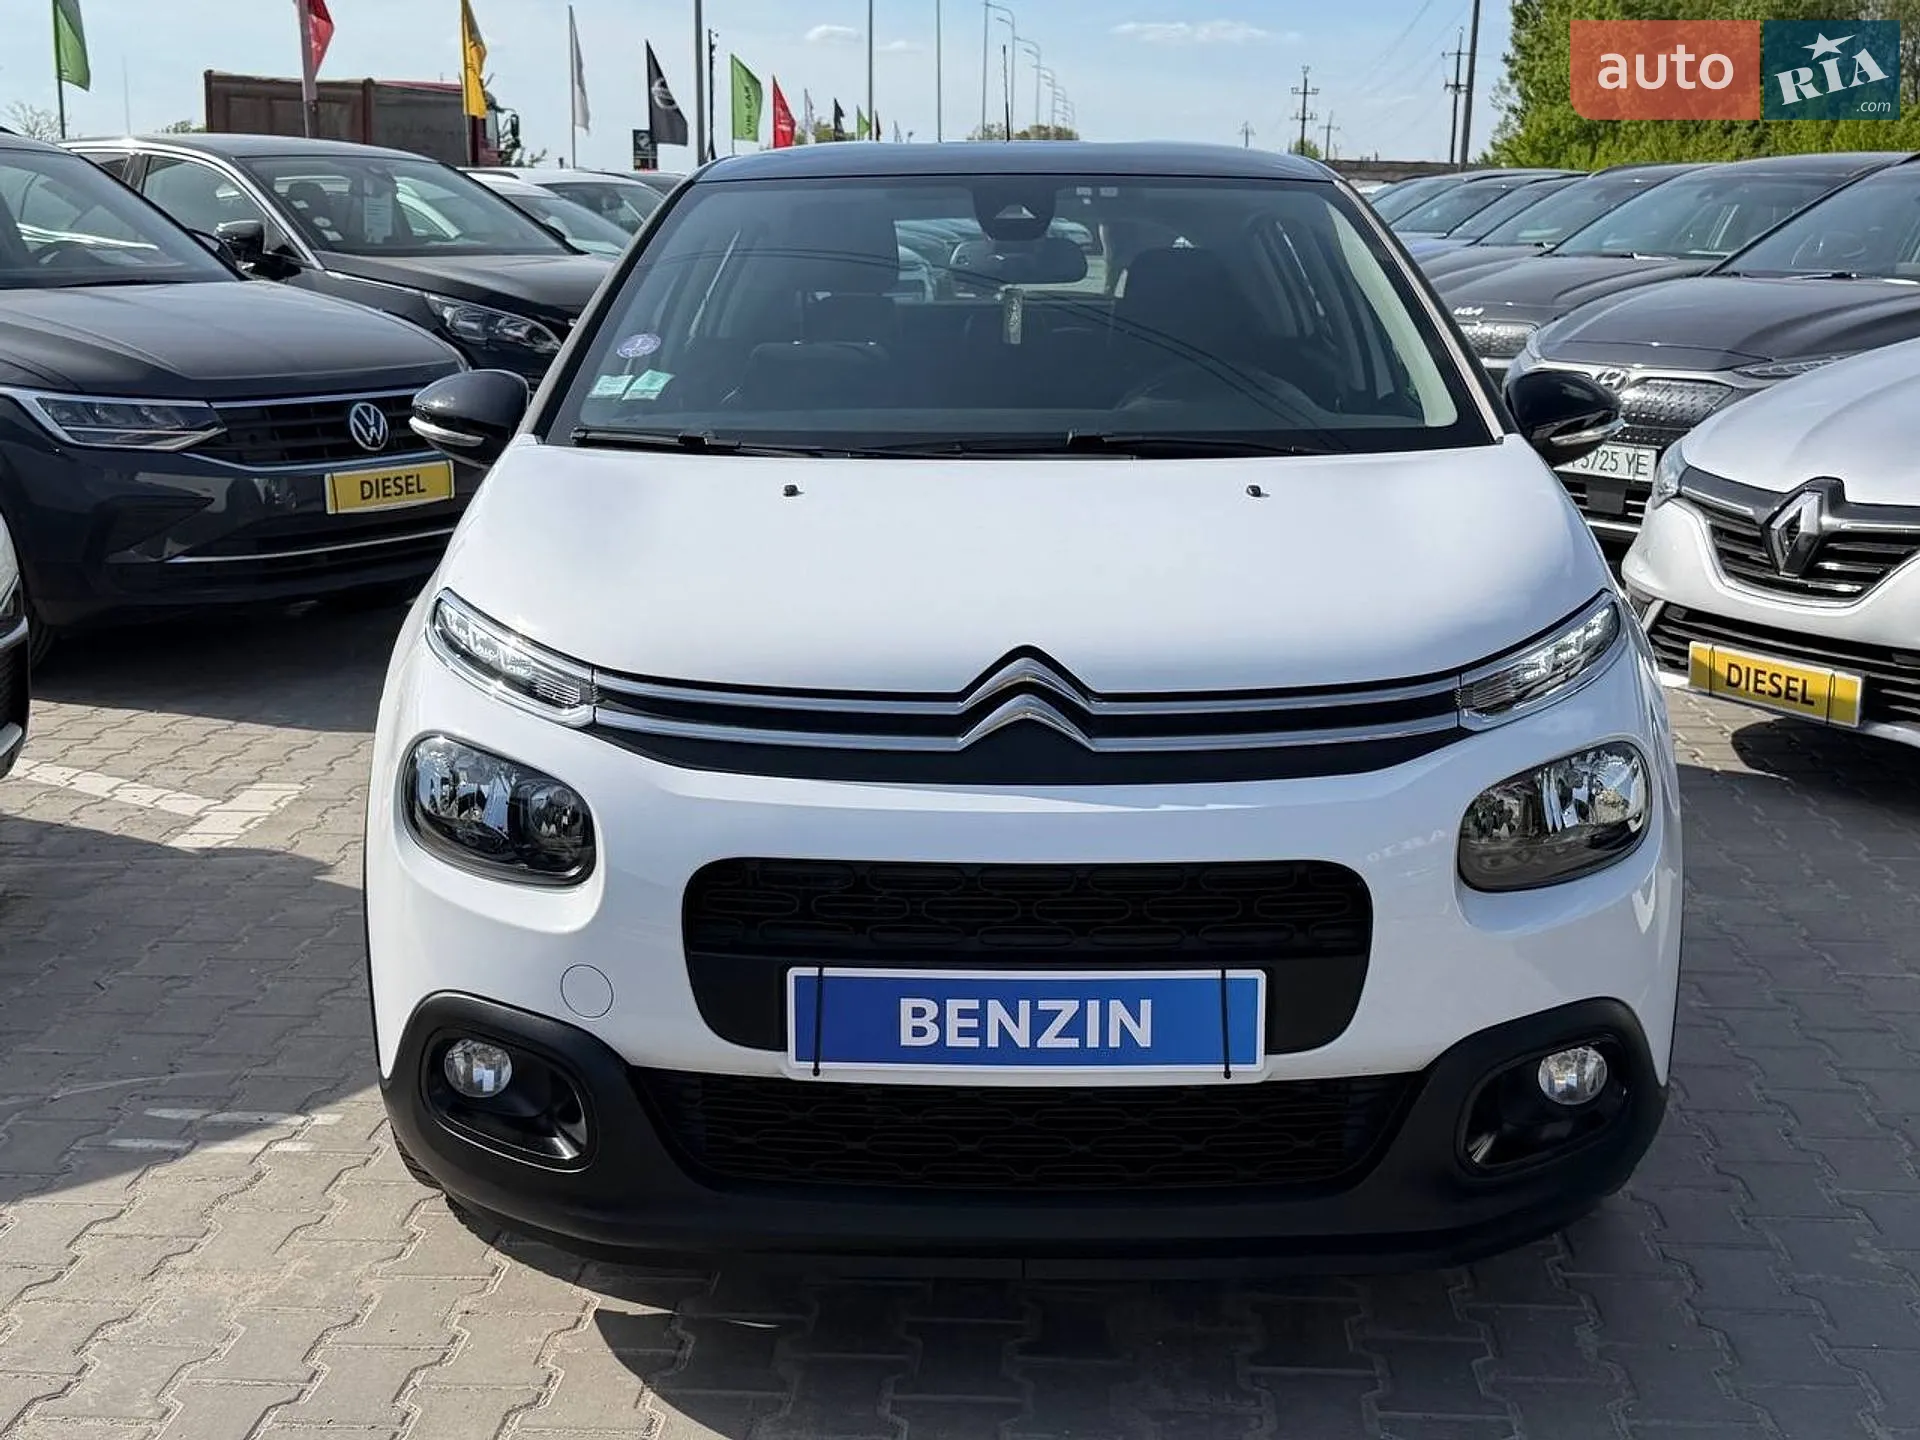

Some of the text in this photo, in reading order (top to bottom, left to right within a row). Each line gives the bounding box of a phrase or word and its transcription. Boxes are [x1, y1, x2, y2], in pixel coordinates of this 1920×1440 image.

[1625, 453, 1649, 476] YE
[360, 473, 427, 501] DIESEL
[1726, 662, 1815, 707] DIESEL
[900, 997, 1152, 1049] BENZIN
